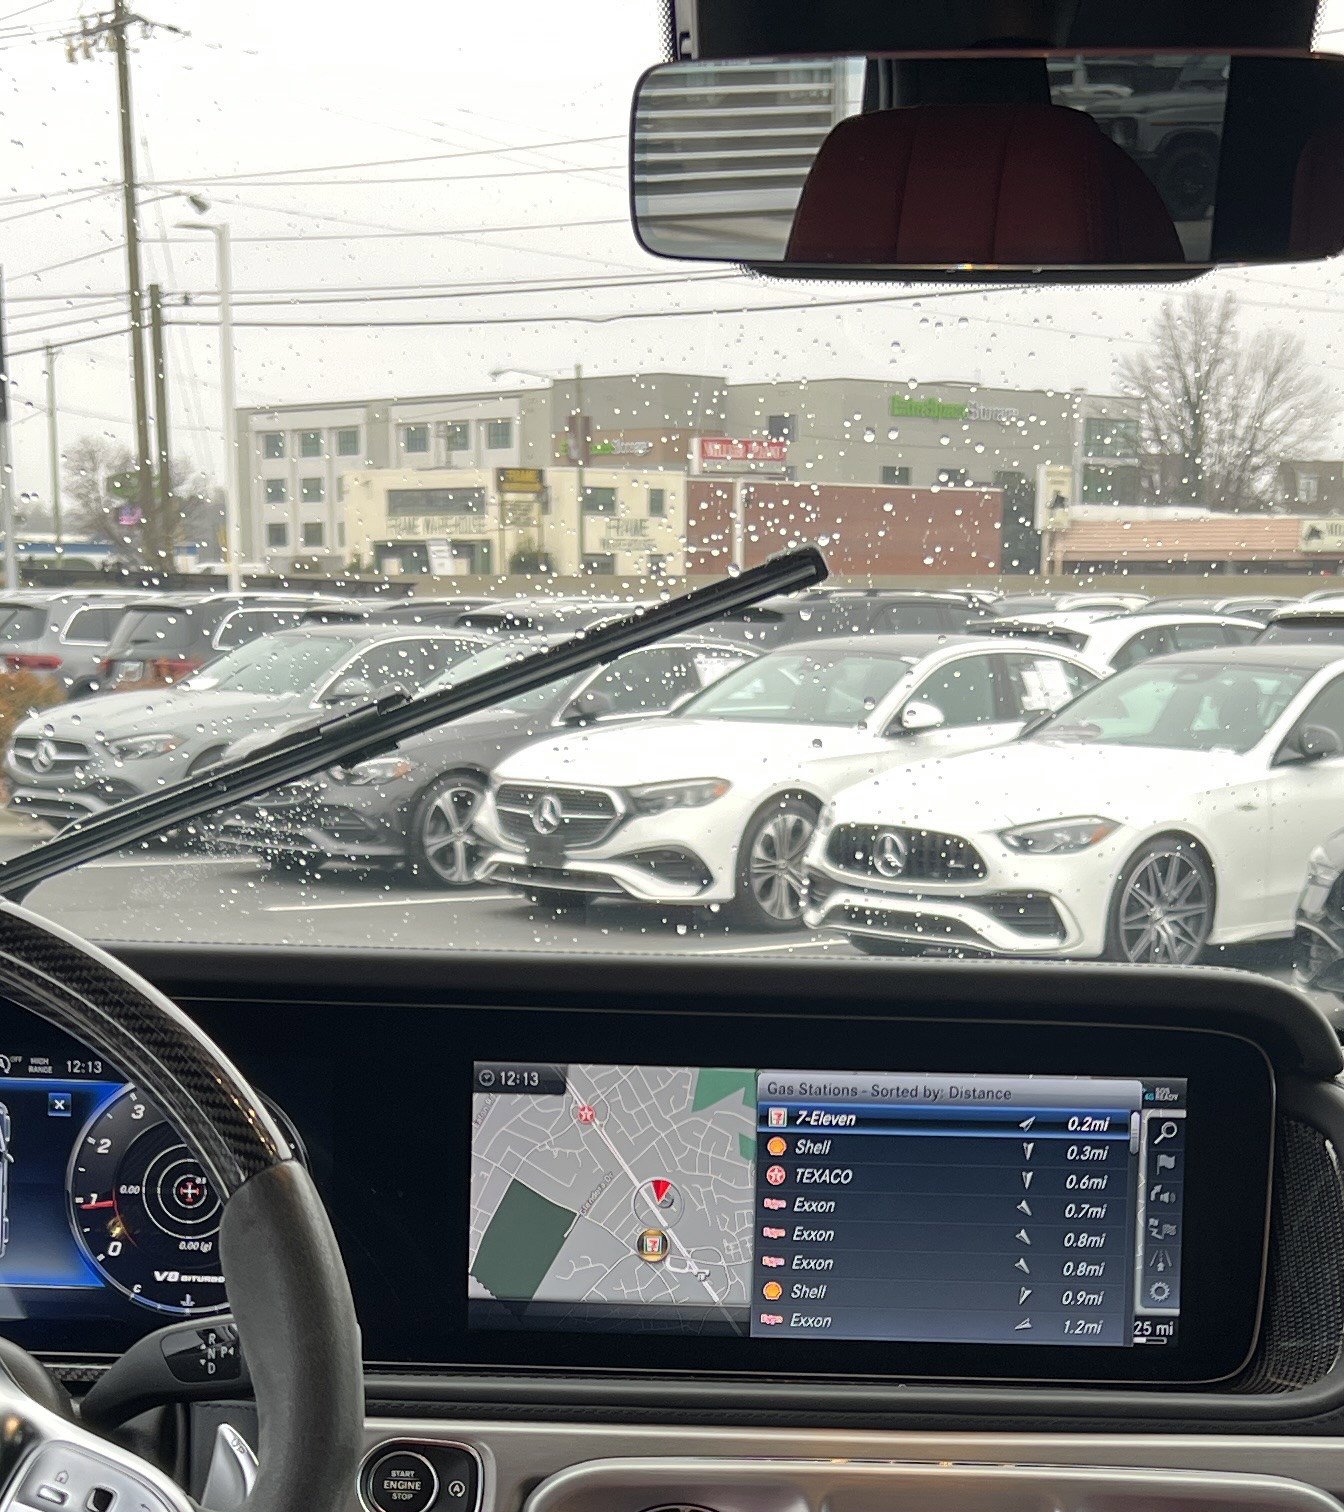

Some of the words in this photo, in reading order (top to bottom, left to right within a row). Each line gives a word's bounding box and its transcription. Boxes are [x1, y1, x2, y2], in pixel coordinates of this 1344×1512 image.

[30, 1057, 49, 1066] HIGH
[66, 1060, 102, 1074] 12:13
[28, 1065, 53, 1074] RANGE
[500, 1071, 539, 1086] 12:13
[767, 1081, 794, 1097] Gas
[799, 1082, 858, 1098] Stations
[871, 1084, 919, 1099] Sorted
[922, 1085, 944, 1102] by:
[949, 1086, 1012, 1100] Distance
[131, 1104, 146, 1120] 3
[795, 1110, 856, 1127] 7-Eleven
[1067, 1116, 1110, 1132] 0.2mi
[97, 1138, 112, 1154] 2
[795, 1139, 831, 1155] Shell
[1066, 1145, 1109, 1161] 0.3mi
[795, 1168, 853, 1185] TEXACO
[1065, 1174, 1108, 1190] 0.6mi
[119, 1185, 140, 1195] 0.00
[793, 1196, 836, 1213] Exxon
[1064, 1203, 1107, 1219] 0.7mi
[792, 1226, 835, 1242] Exxon
[1063, 1232, 1106, 1248] 0.8mi
[108, 1241, 122, 1257] 0
[178, 1242, 199, 1251] 0.00
[791, 1255, 834, 1271] Exxon
[1062, 1261, 1105, 1277] 0.8mi
[153, 1271, 180, 1282] V8
[790, 1284, 827, 1300] Shell
[1062, 1290, 1104, 1306] 0.9mi
[790, 1313, 832, 1329] Exxon
[1063, 1320, 1104, 1335] 1.2mi
[1156, 1321, 1174, 1336] mi
[208, 1333, 217, 1345] R
[207, 1348, 216, 1360] N
[220, 1346, 228, 1359] P
[207, 1362, 216, 1375] D
[391, 1470, 415, 1478] START
[383, 1480, 422, 1491] ENGINE
[391, 1492, 413, 1501] STOP
